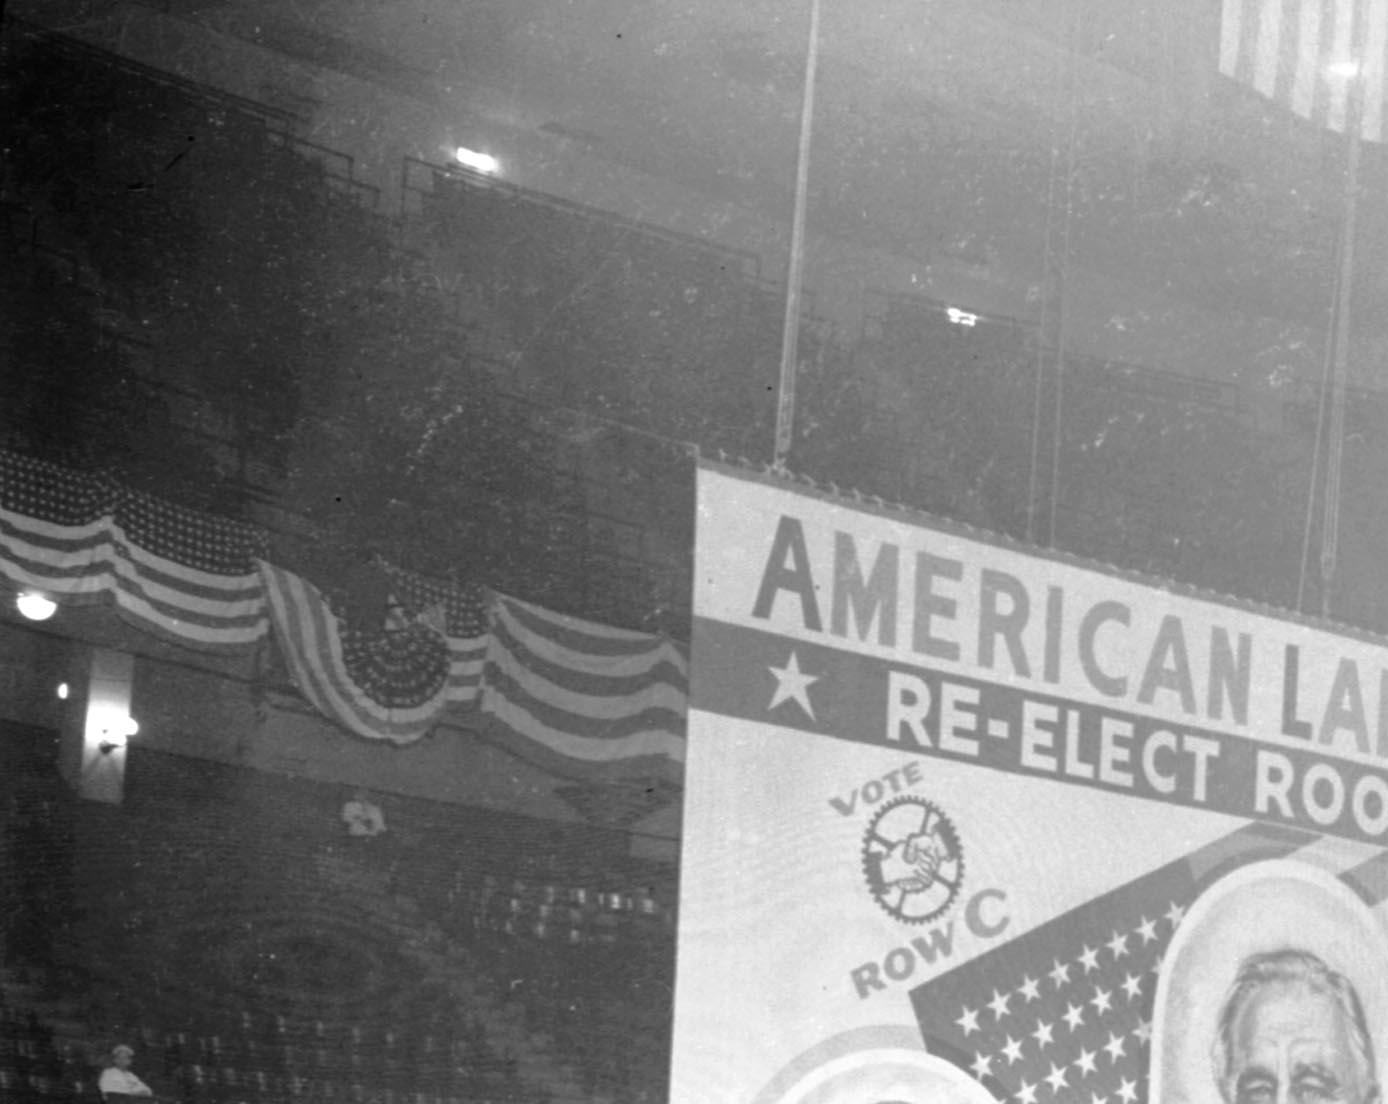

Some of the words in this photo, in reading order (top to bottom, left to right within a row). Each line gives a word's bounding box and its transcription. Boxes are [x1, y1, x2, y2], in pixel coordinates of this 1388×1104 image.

[752, 514, 1253, 727] AMERICAN
[828, 760, 925, 818] VOTE
[886, 670, 1221, 802] RE-ELECT
[850, 920, 955, 1000] ROW
[964, 887, 1011, 939] C
